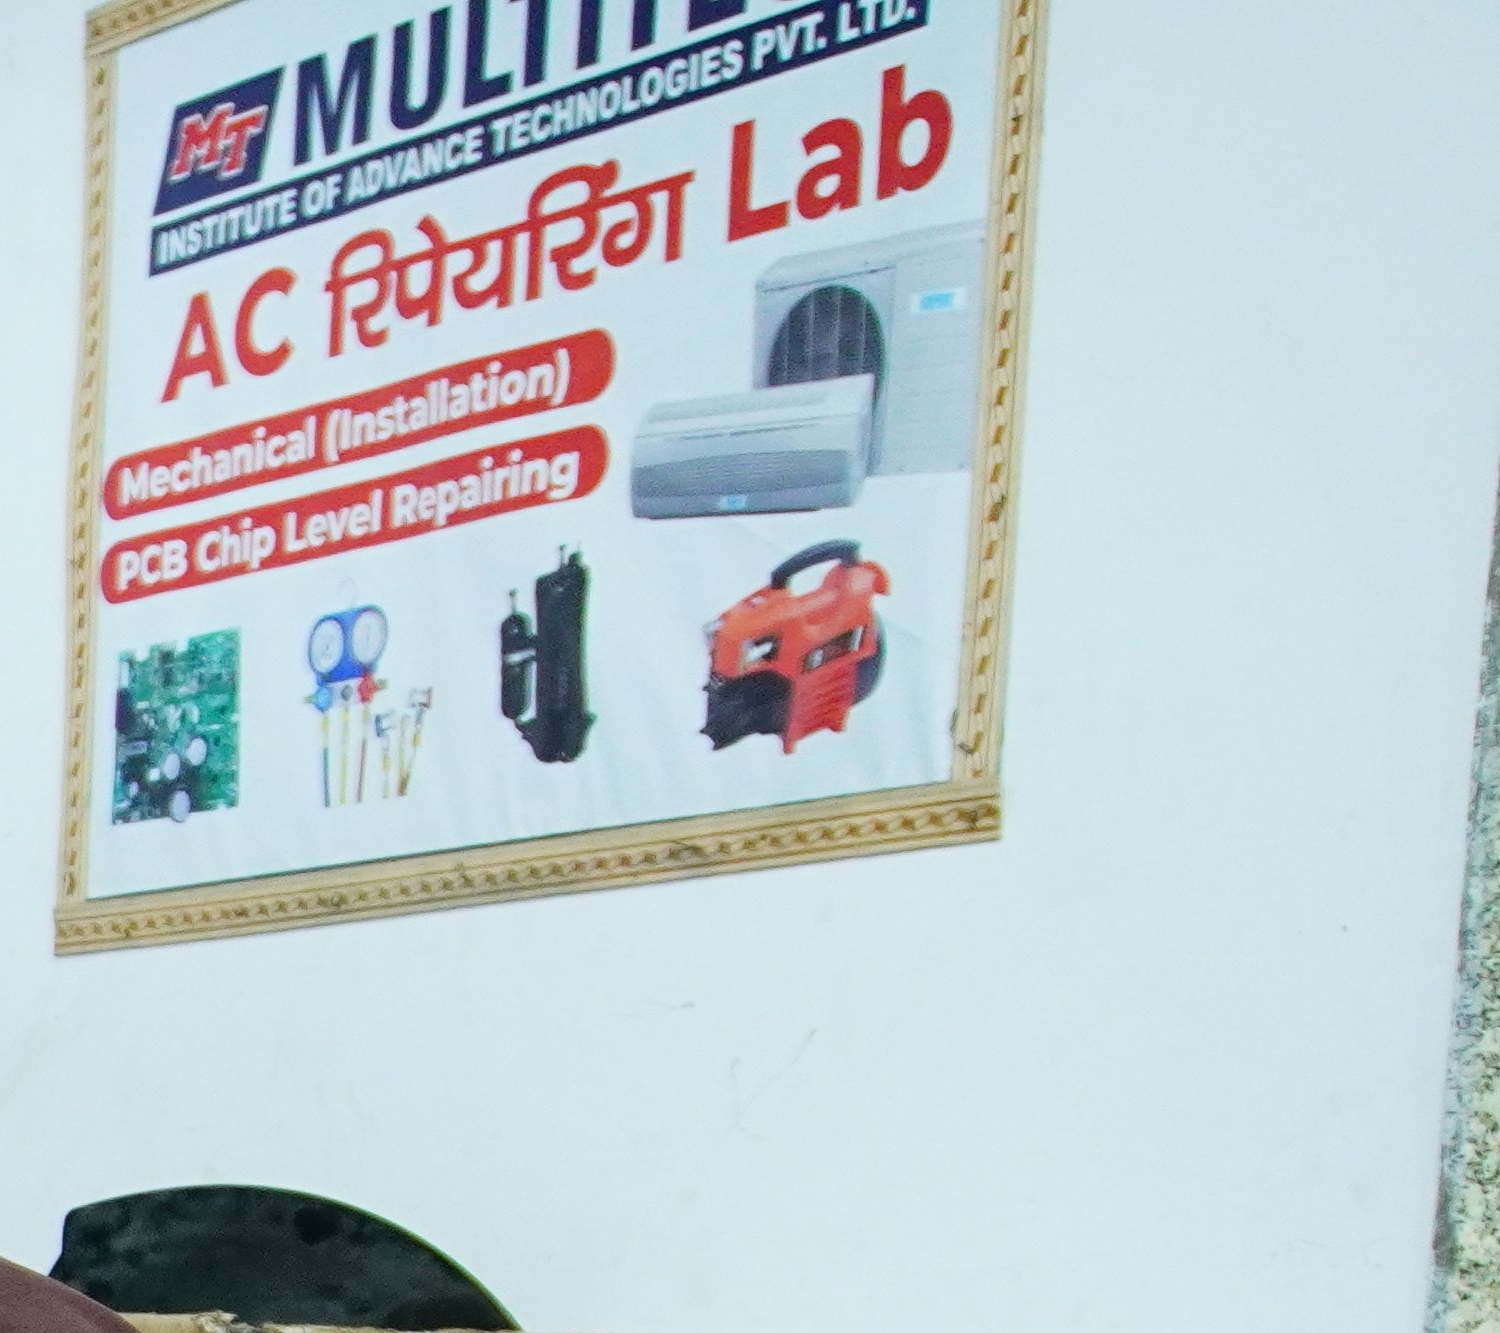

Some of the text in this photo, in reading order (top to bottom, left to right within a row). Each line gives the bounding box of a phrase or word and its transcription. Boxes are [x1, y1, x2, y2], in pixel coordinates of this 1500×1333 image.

[157, 195, 297, 266] INSTITUTE
[304, 178, 344, 219] OF
[347, 128, 484, 201] ADVANCE
[490, 40, 744, 154] TECHNOLOGIES
[751, 12, 827, 72] PVT.
[170, 102, 267, 184] MT
[294, 0, 790, 166] MULTI
[161, 64, 953, 402] AC रिपेयरिंग Lab
[118, 348, 570, 506] Mechanical (Installation)
[116, 449, 580, 592] PCB Chip Level Repairing
